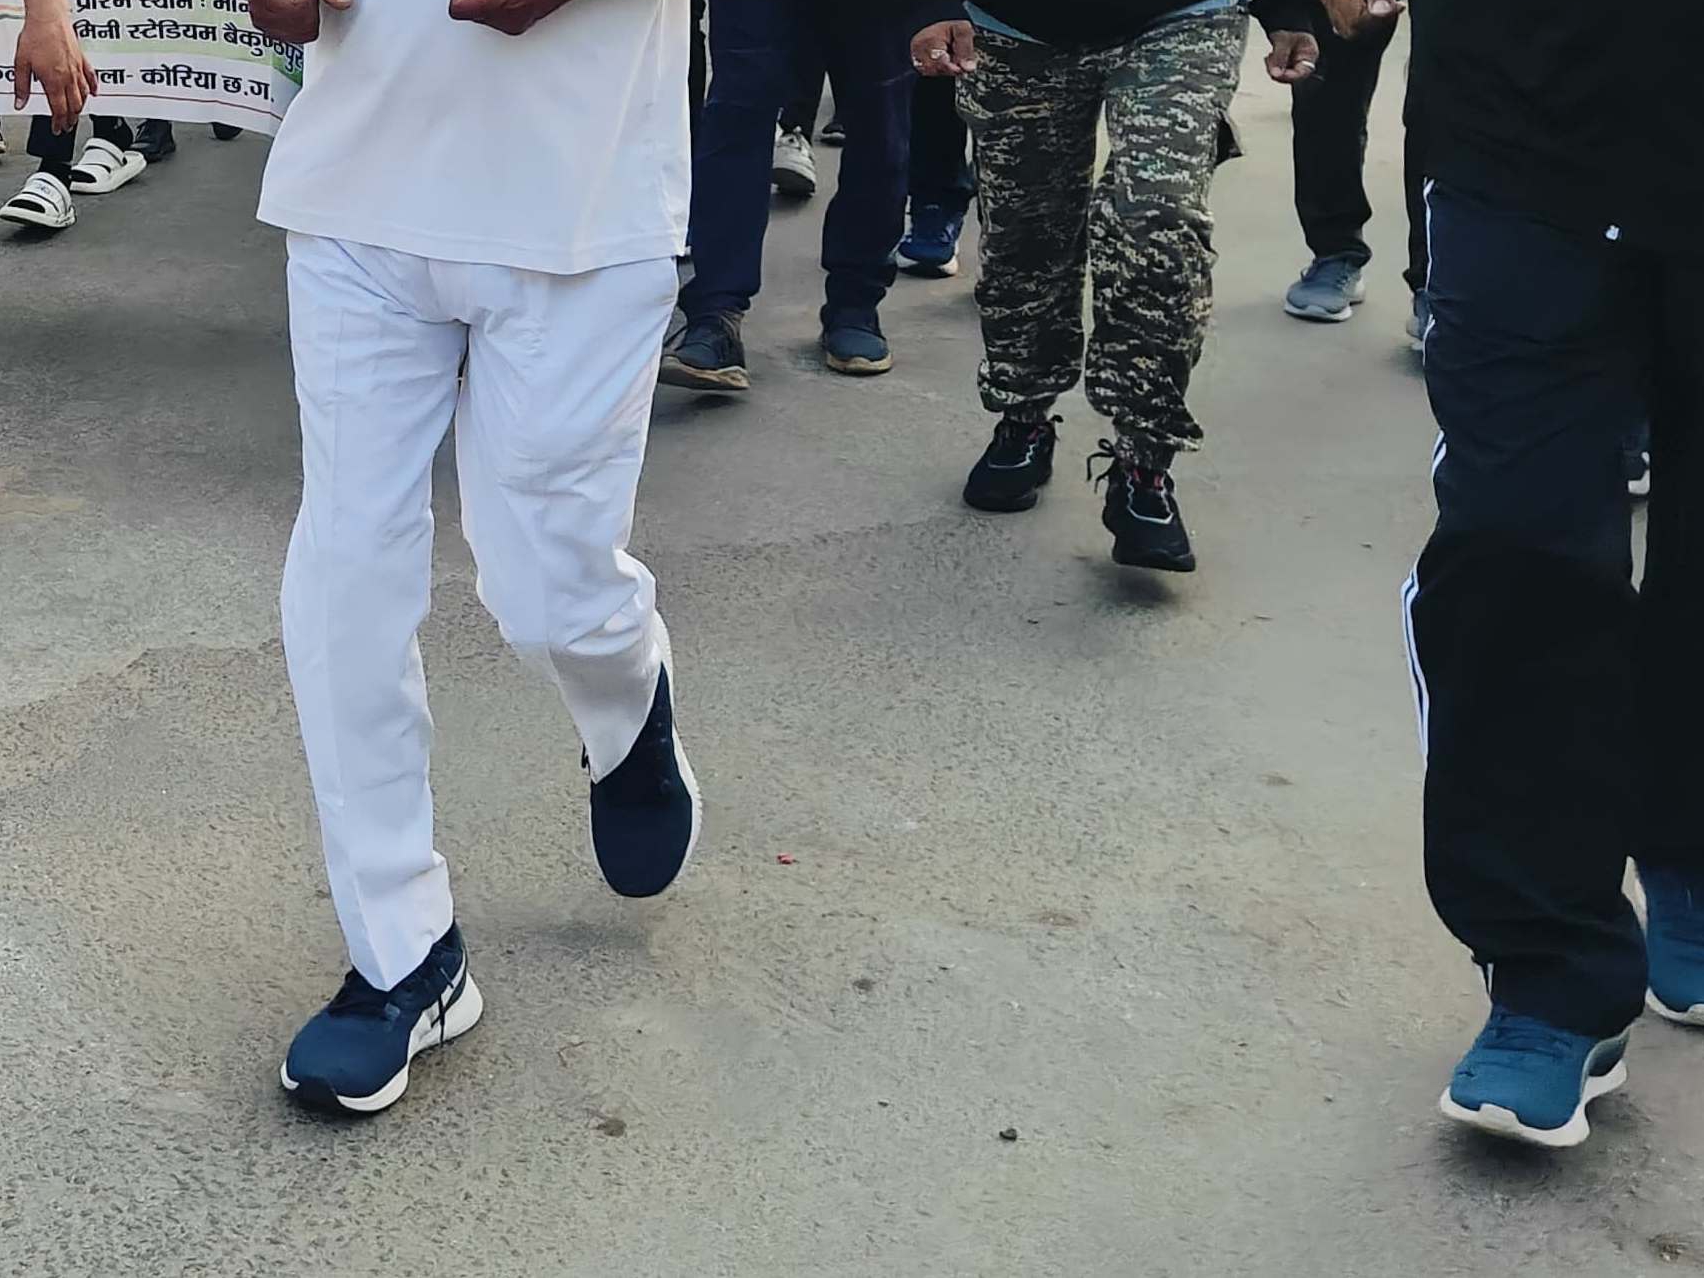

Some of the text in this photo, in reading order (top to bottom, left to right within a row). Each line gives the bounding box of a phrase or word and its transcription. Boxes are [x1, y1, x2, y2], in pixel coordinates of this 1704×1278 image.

[72, 18, 121, 40] मिनी
[127, 17, 217, 42] स्टेडियम
[140, 64, 275, 103] कोरिया छ.ग.
